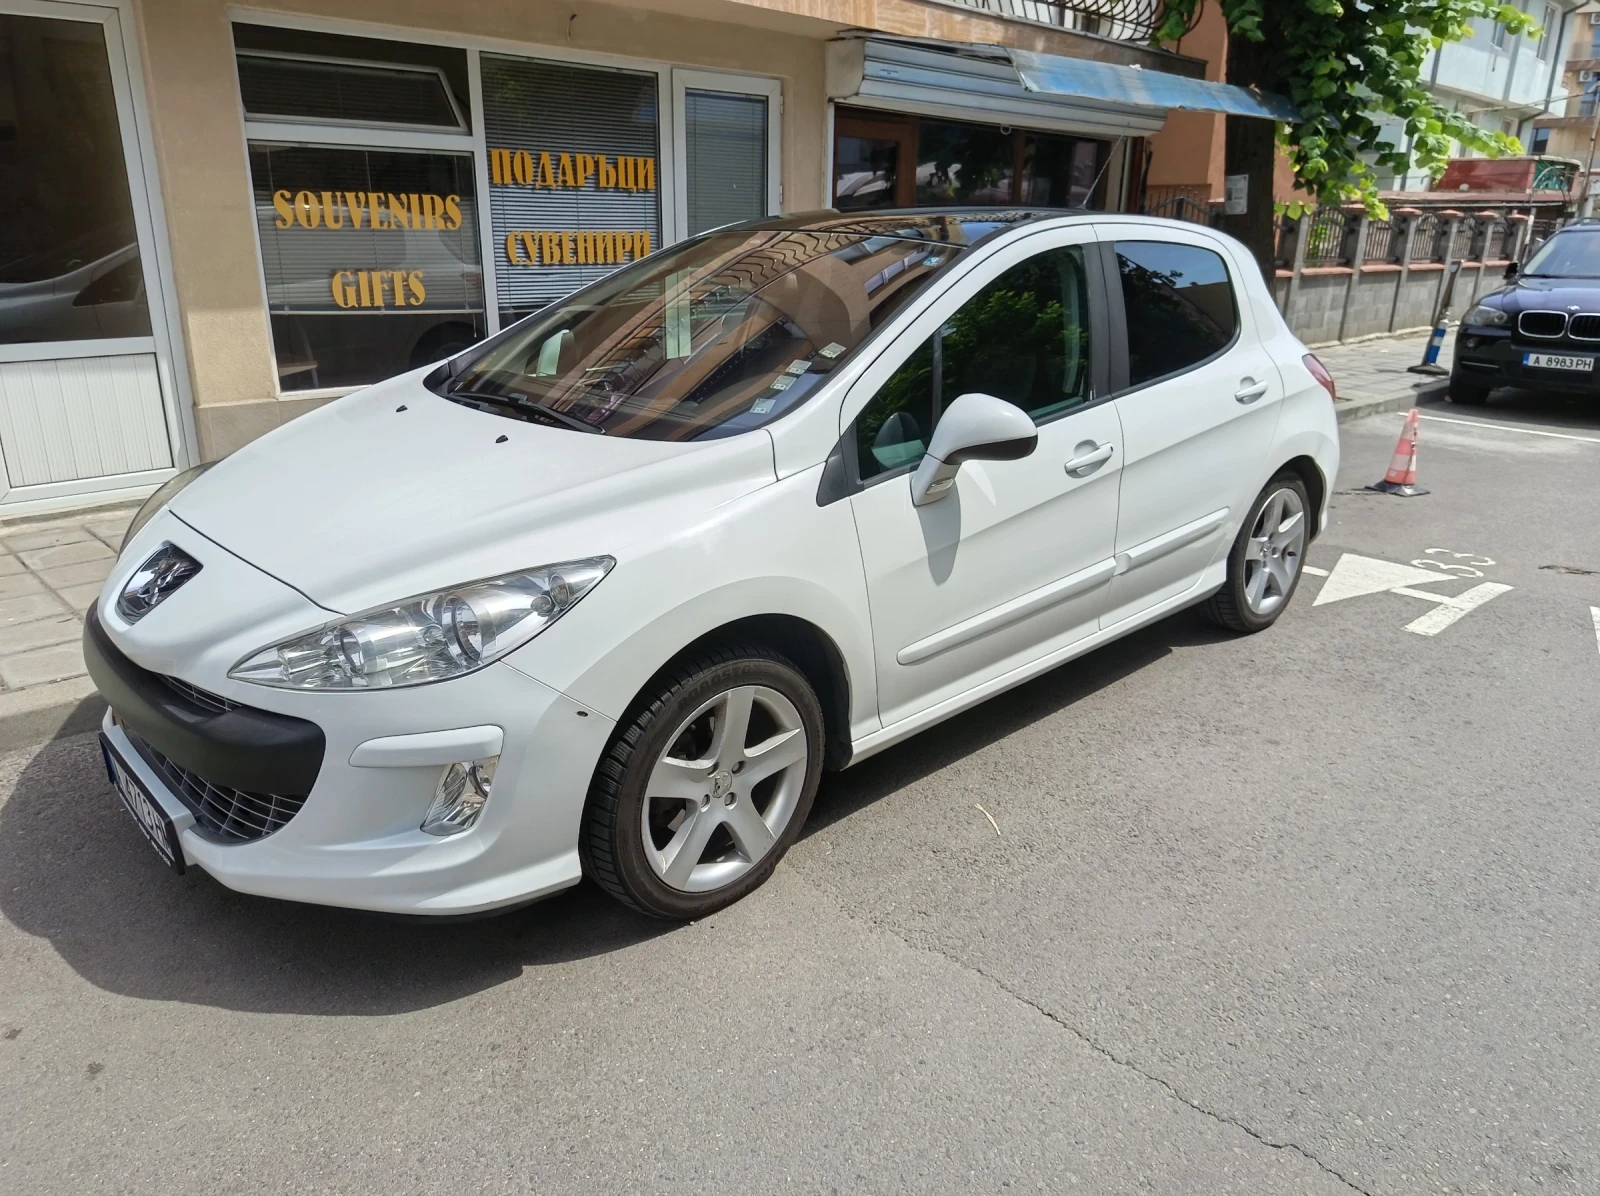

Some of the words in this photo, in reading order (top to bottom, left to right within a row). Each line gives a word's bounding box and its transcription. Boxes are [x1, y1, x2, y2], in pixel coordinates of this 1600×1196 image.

[490, 148, 656, 193] ПОДАРЪЦИ
[272, 189, 463, 230] SOUVENIRS
[506, 230, 652, 266] СУВЕНИРИ
[331, 269, 427, 309] GIFTS
[1533, 355, 1540, 366] A
[1545, 356, 1574, 369] 8983
[1575, 358, 1592, 370] PH
